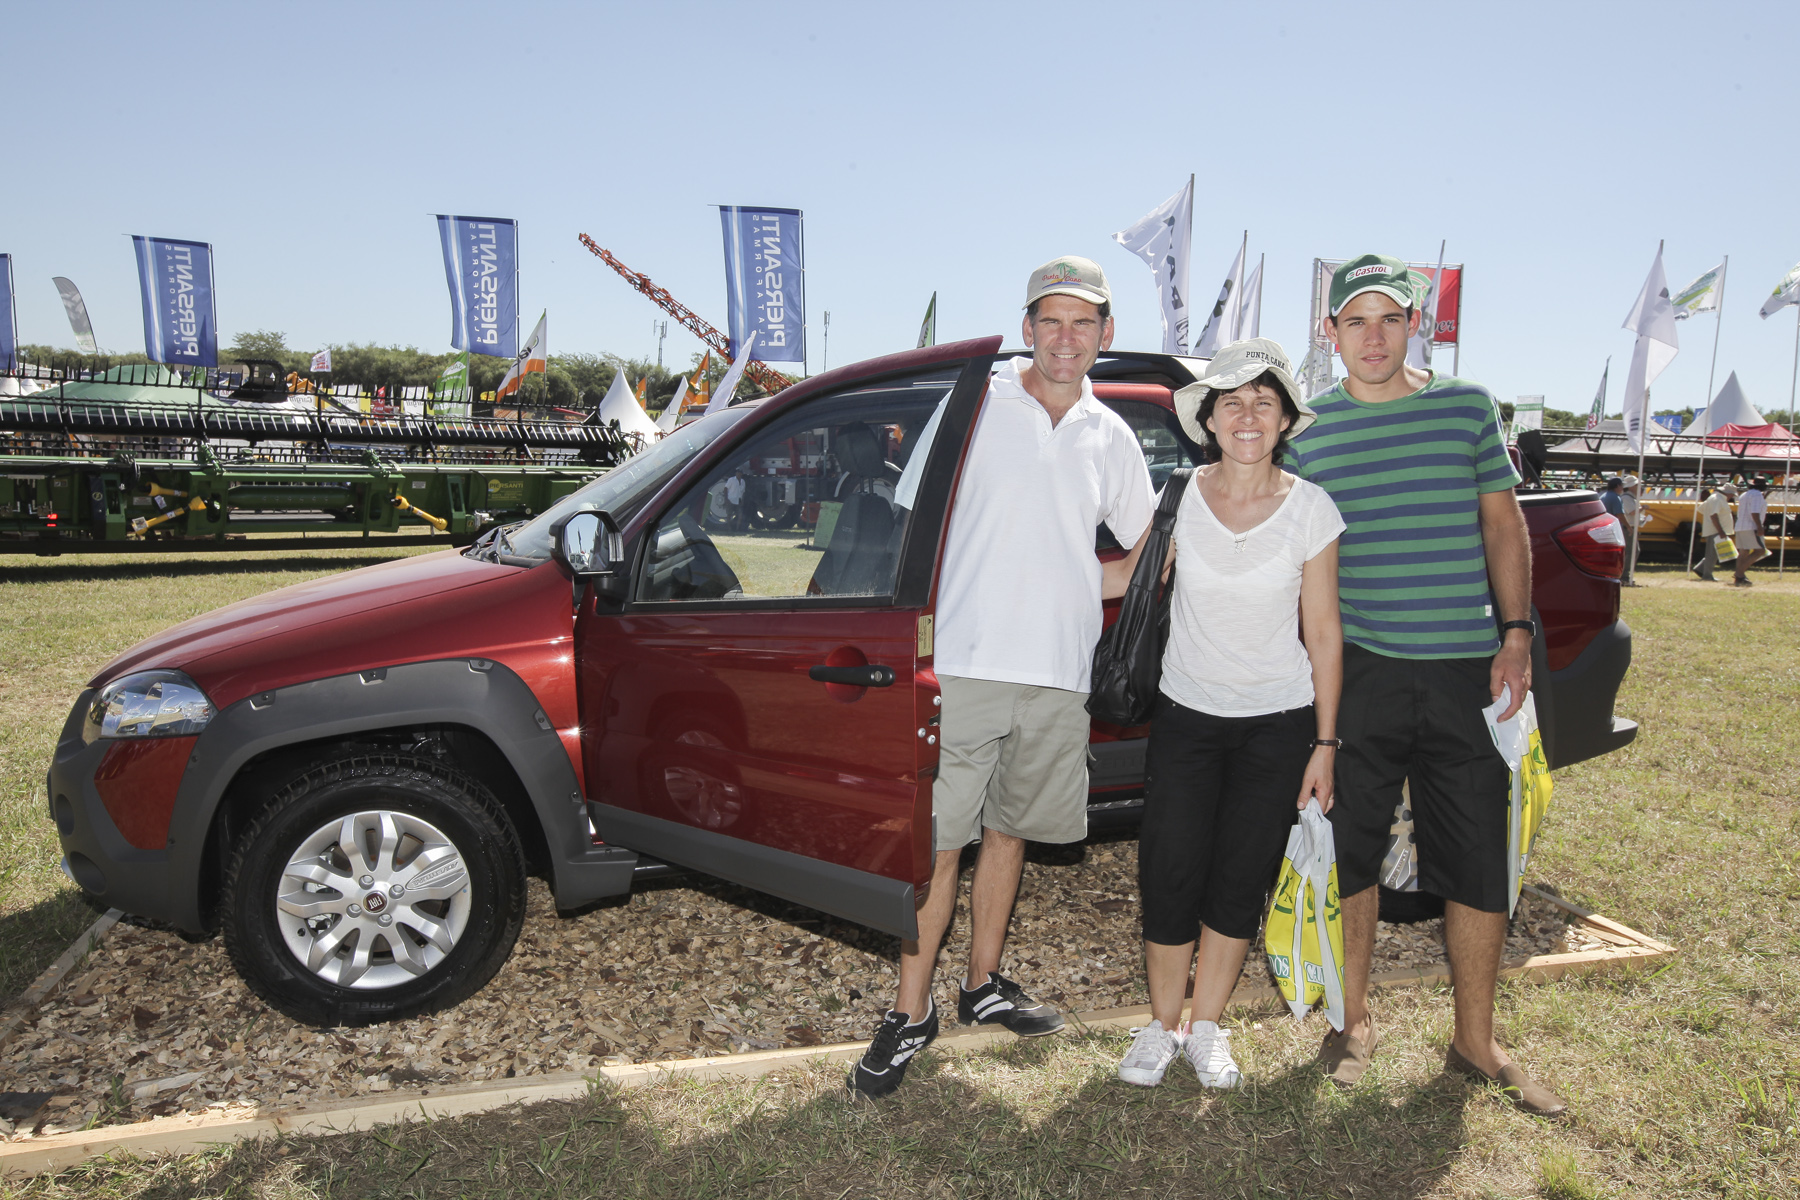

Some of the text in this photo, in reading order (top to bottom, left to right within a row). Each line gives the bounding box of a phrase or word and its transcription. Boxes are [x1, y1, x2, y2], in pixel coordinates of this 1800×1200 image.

[1042, 273, 1060, 282] Punta
[1355, 266, 1387, 277] Castrol
[1245, 351, 1286, 371] PUNTA CANA
[368, 895, 383, 910] FIAT
